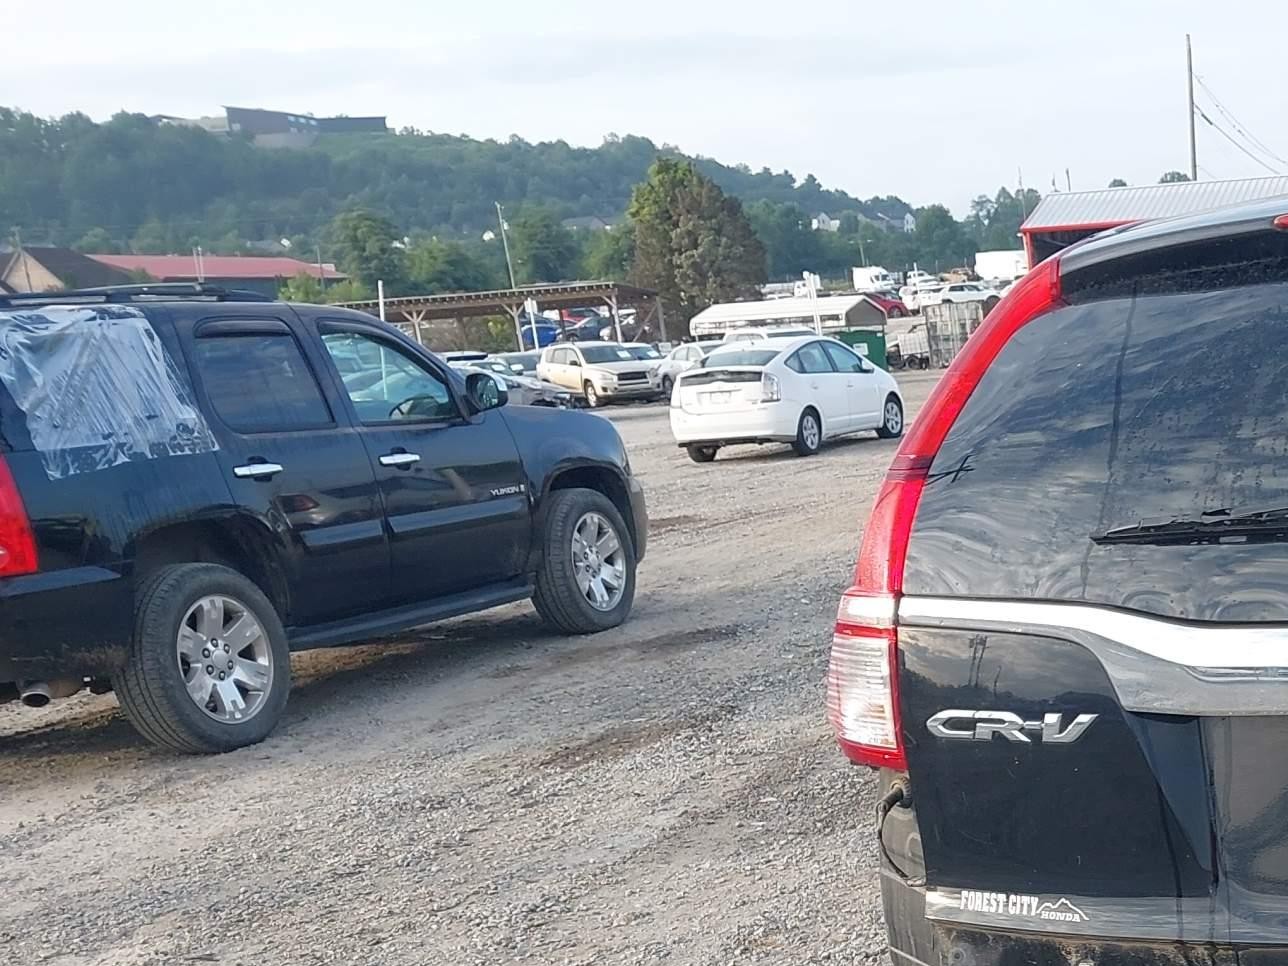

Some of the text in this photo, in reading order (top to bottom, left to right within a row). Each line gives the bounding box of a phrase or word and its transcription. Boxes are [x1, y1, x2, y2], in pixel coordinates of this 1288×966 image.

[490, 486, 519, 496] YUKON
[925, 708, 1100, 744] CR-V
[960, 890, 1039, 916] FOREST CITY
[1040, 910, 1081, 923] HONDA
